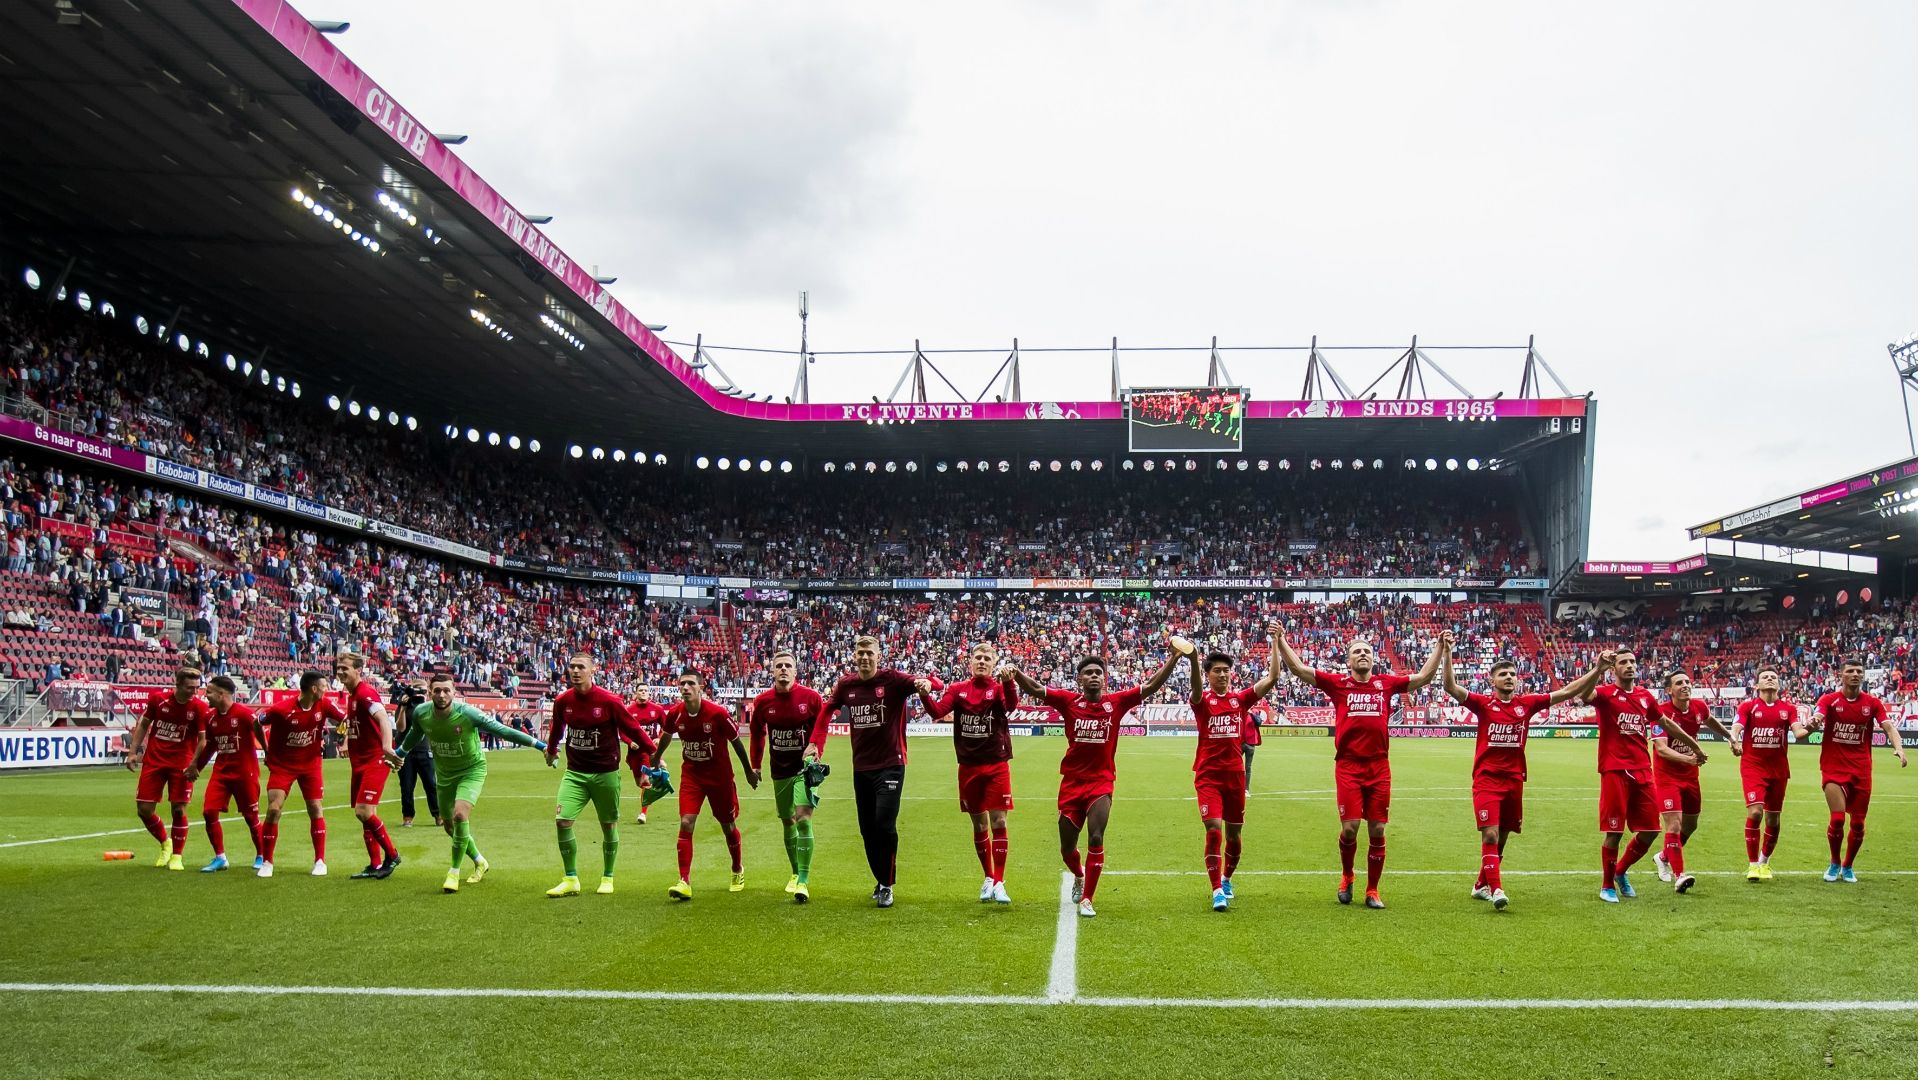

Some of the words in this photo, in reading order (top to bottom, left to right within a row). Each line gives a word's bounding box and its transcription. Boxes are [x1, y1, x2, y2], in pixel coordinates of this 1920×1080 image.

[364, 88, 430, 158] CLUB
[501, 205, 568, 276] TWENTE
[842, 405, 870, 420] FC
[878, 405, 973, 420] TWENTE
[1363, 402, 1434, 416] SINDS
[1445, 401, 1495, 416] 1965
[34, 426, 49, 442] Ga
[50, 432, 74, 449] naar
[76, 440, 113, 459] geas.nl
[157, 461, 198, 483] Rabobank
[208, 474, 244, 495] Rabobank
[255, 489, 288, 505] Rabobank
[296, 500, 325, 517] Rabobank
[1589, 564, 1608, 572] hein
[1620, 564, 1643, 572] heun
[1285, 579, 1306, 587] paint
[129, 595, 161, 609] revider
[1347, 693, 1371, 706] pure
[851, 704, 870, 718] pure
[1350, 703, 1377, 711] energie
[854, 715, 878, 724] energie
[960, 713, 980, 725] pure
[1208, 715, 1231, 728] pure
[1618, 712, 1640, 726] pure
[962, 724, 986, 733] energie
[1074, 719, 1099, 732] pure
[1211, 725, 1237, 734] energie
[1488, 723, 1512, 736] pure
[1833, 721, 1856, 732] pure
[288, 731, 309, 741] pure
[772, 729, 792, 740] pure
[1077, 729, 1104, 738] energie
[1389, 728, 1450, 737] OULEVARD
[1491, 733, 1518, 743] energie
[1528, 729, 1550, 737] WAY
[1554, 729, 1592, 737] SUBWAY
[1752, 727, 1774, 738] pure
[1835, 731, 1860, 740] energie
[571, 738, 592, 747] energie
[775, 738, 799, 747] energie
[1754, 736, 1779, 744] energie
[685, 750, 707, 758] energie
